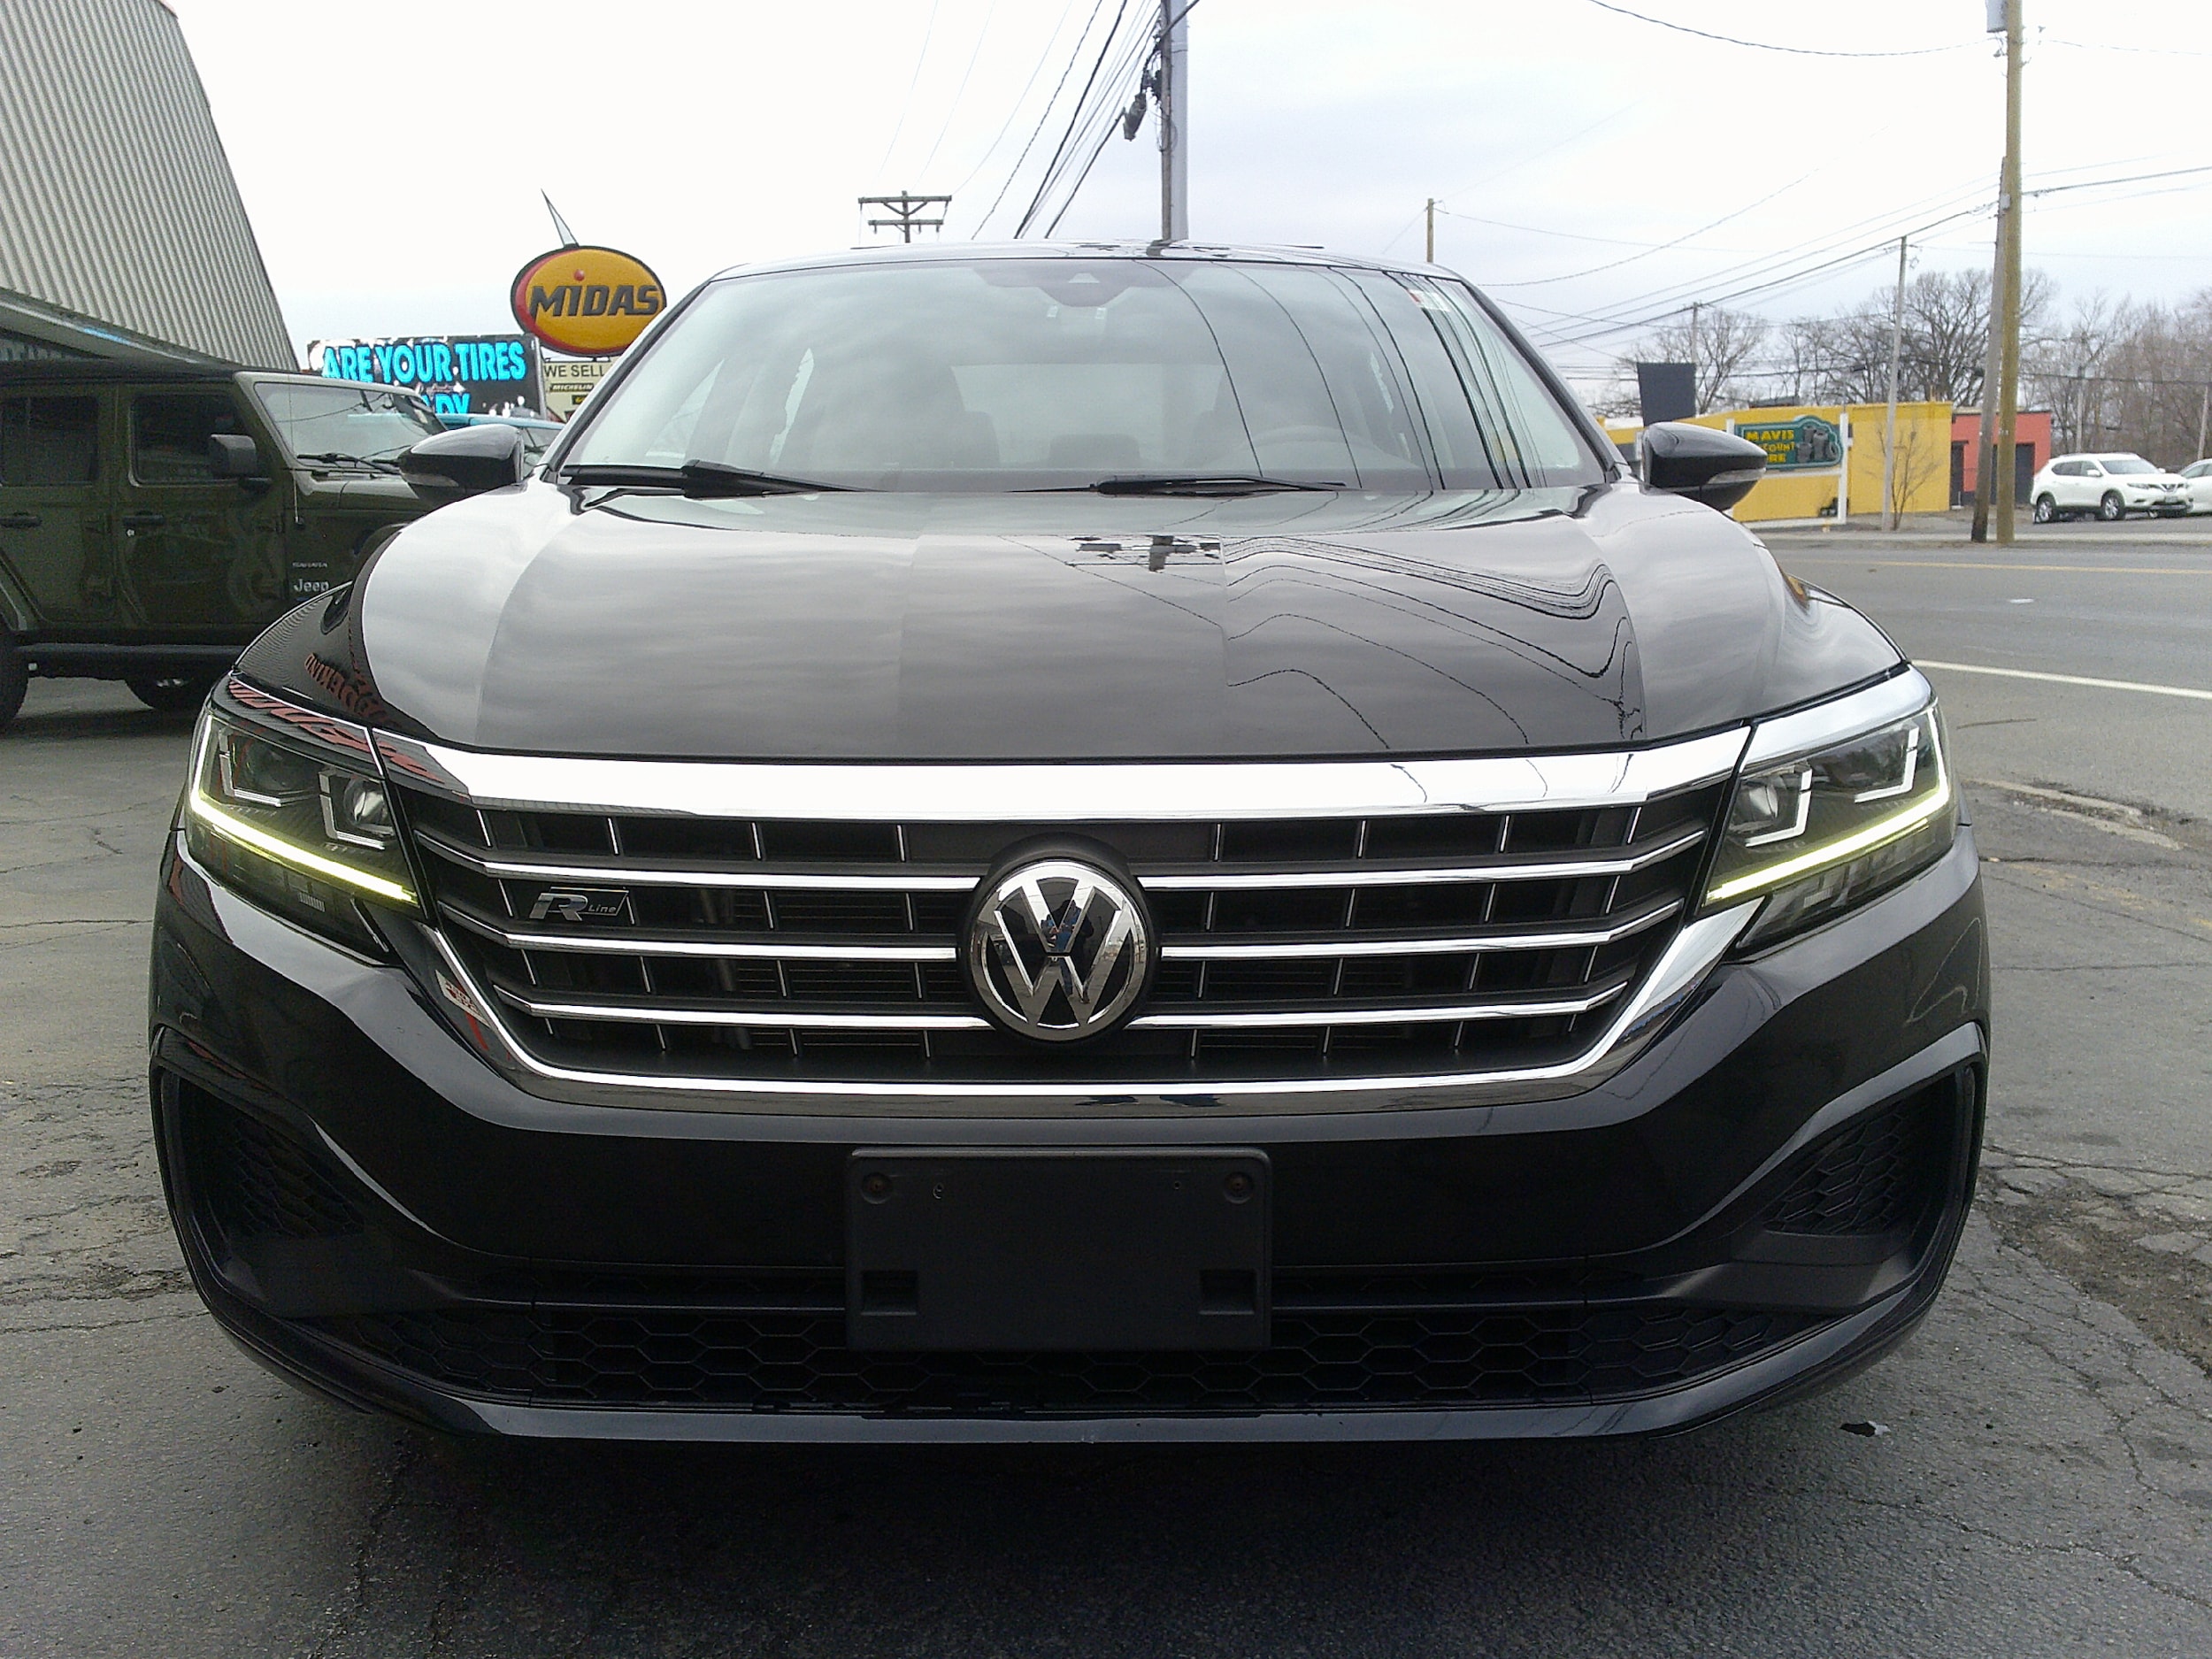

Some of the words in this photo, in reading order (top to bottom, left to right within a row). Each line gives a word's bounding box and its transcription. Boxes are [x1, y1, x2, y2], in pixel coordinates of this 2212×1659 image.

[529, 270, 660, 324] MIDAS
[321, 346, 373, 382] ARE
[374, 344, 452, 383] YOUR
[455, 342, 526, 381] TIRES
[543, 365, 567, 378] WE
[571, 365, 605, 378] SELL
[1747, 429, 1794, 441] MAVIS
[293, 578, 329, 592] Jeep
[529, 892, 588, 921] R
[588, 903, 618, 914] Line
